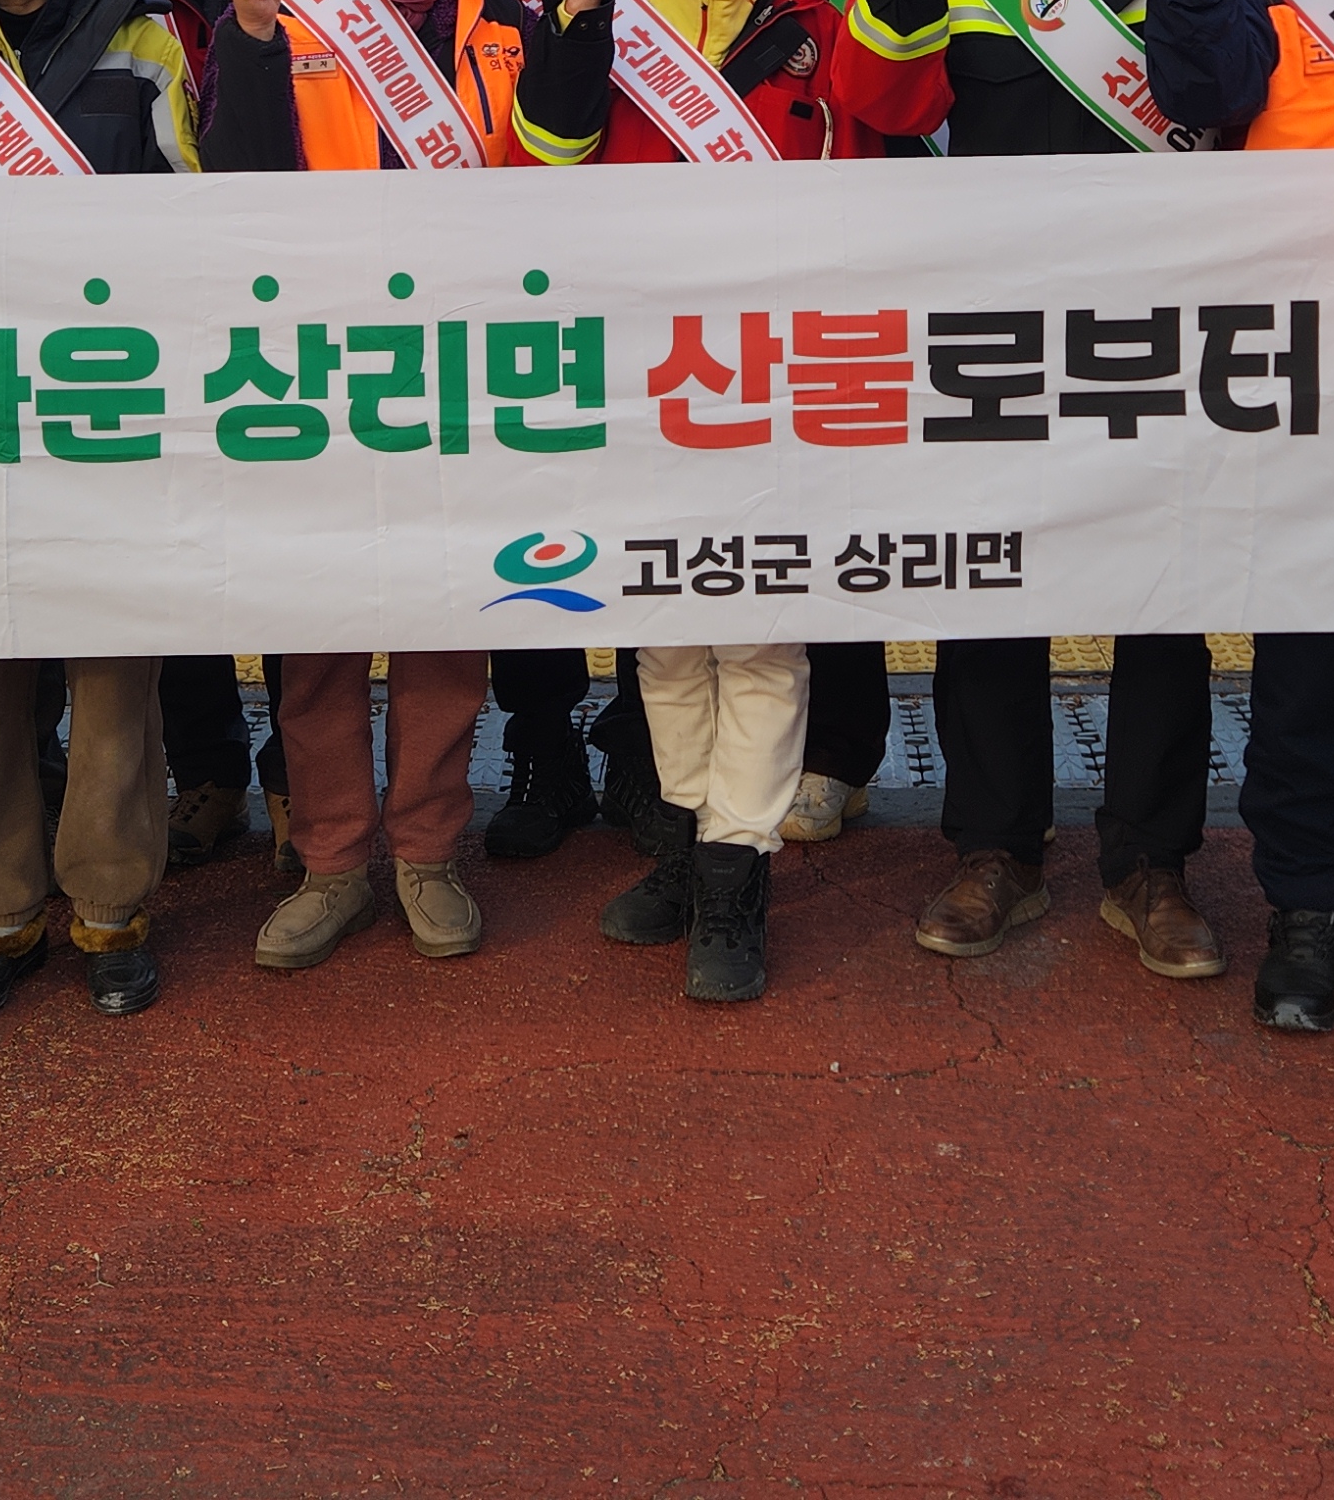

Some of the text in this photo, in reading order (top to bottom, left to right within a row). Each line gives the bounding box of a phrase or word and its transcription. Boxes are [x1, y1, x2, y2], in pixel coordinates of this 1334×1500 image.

[415, 120, 471, 169] 방
[204, 316, 607, 462] 상리면
[645, 299, 1323, 449] 산불로부터
[621, 531, 1023, 597] 고성군 상리면
